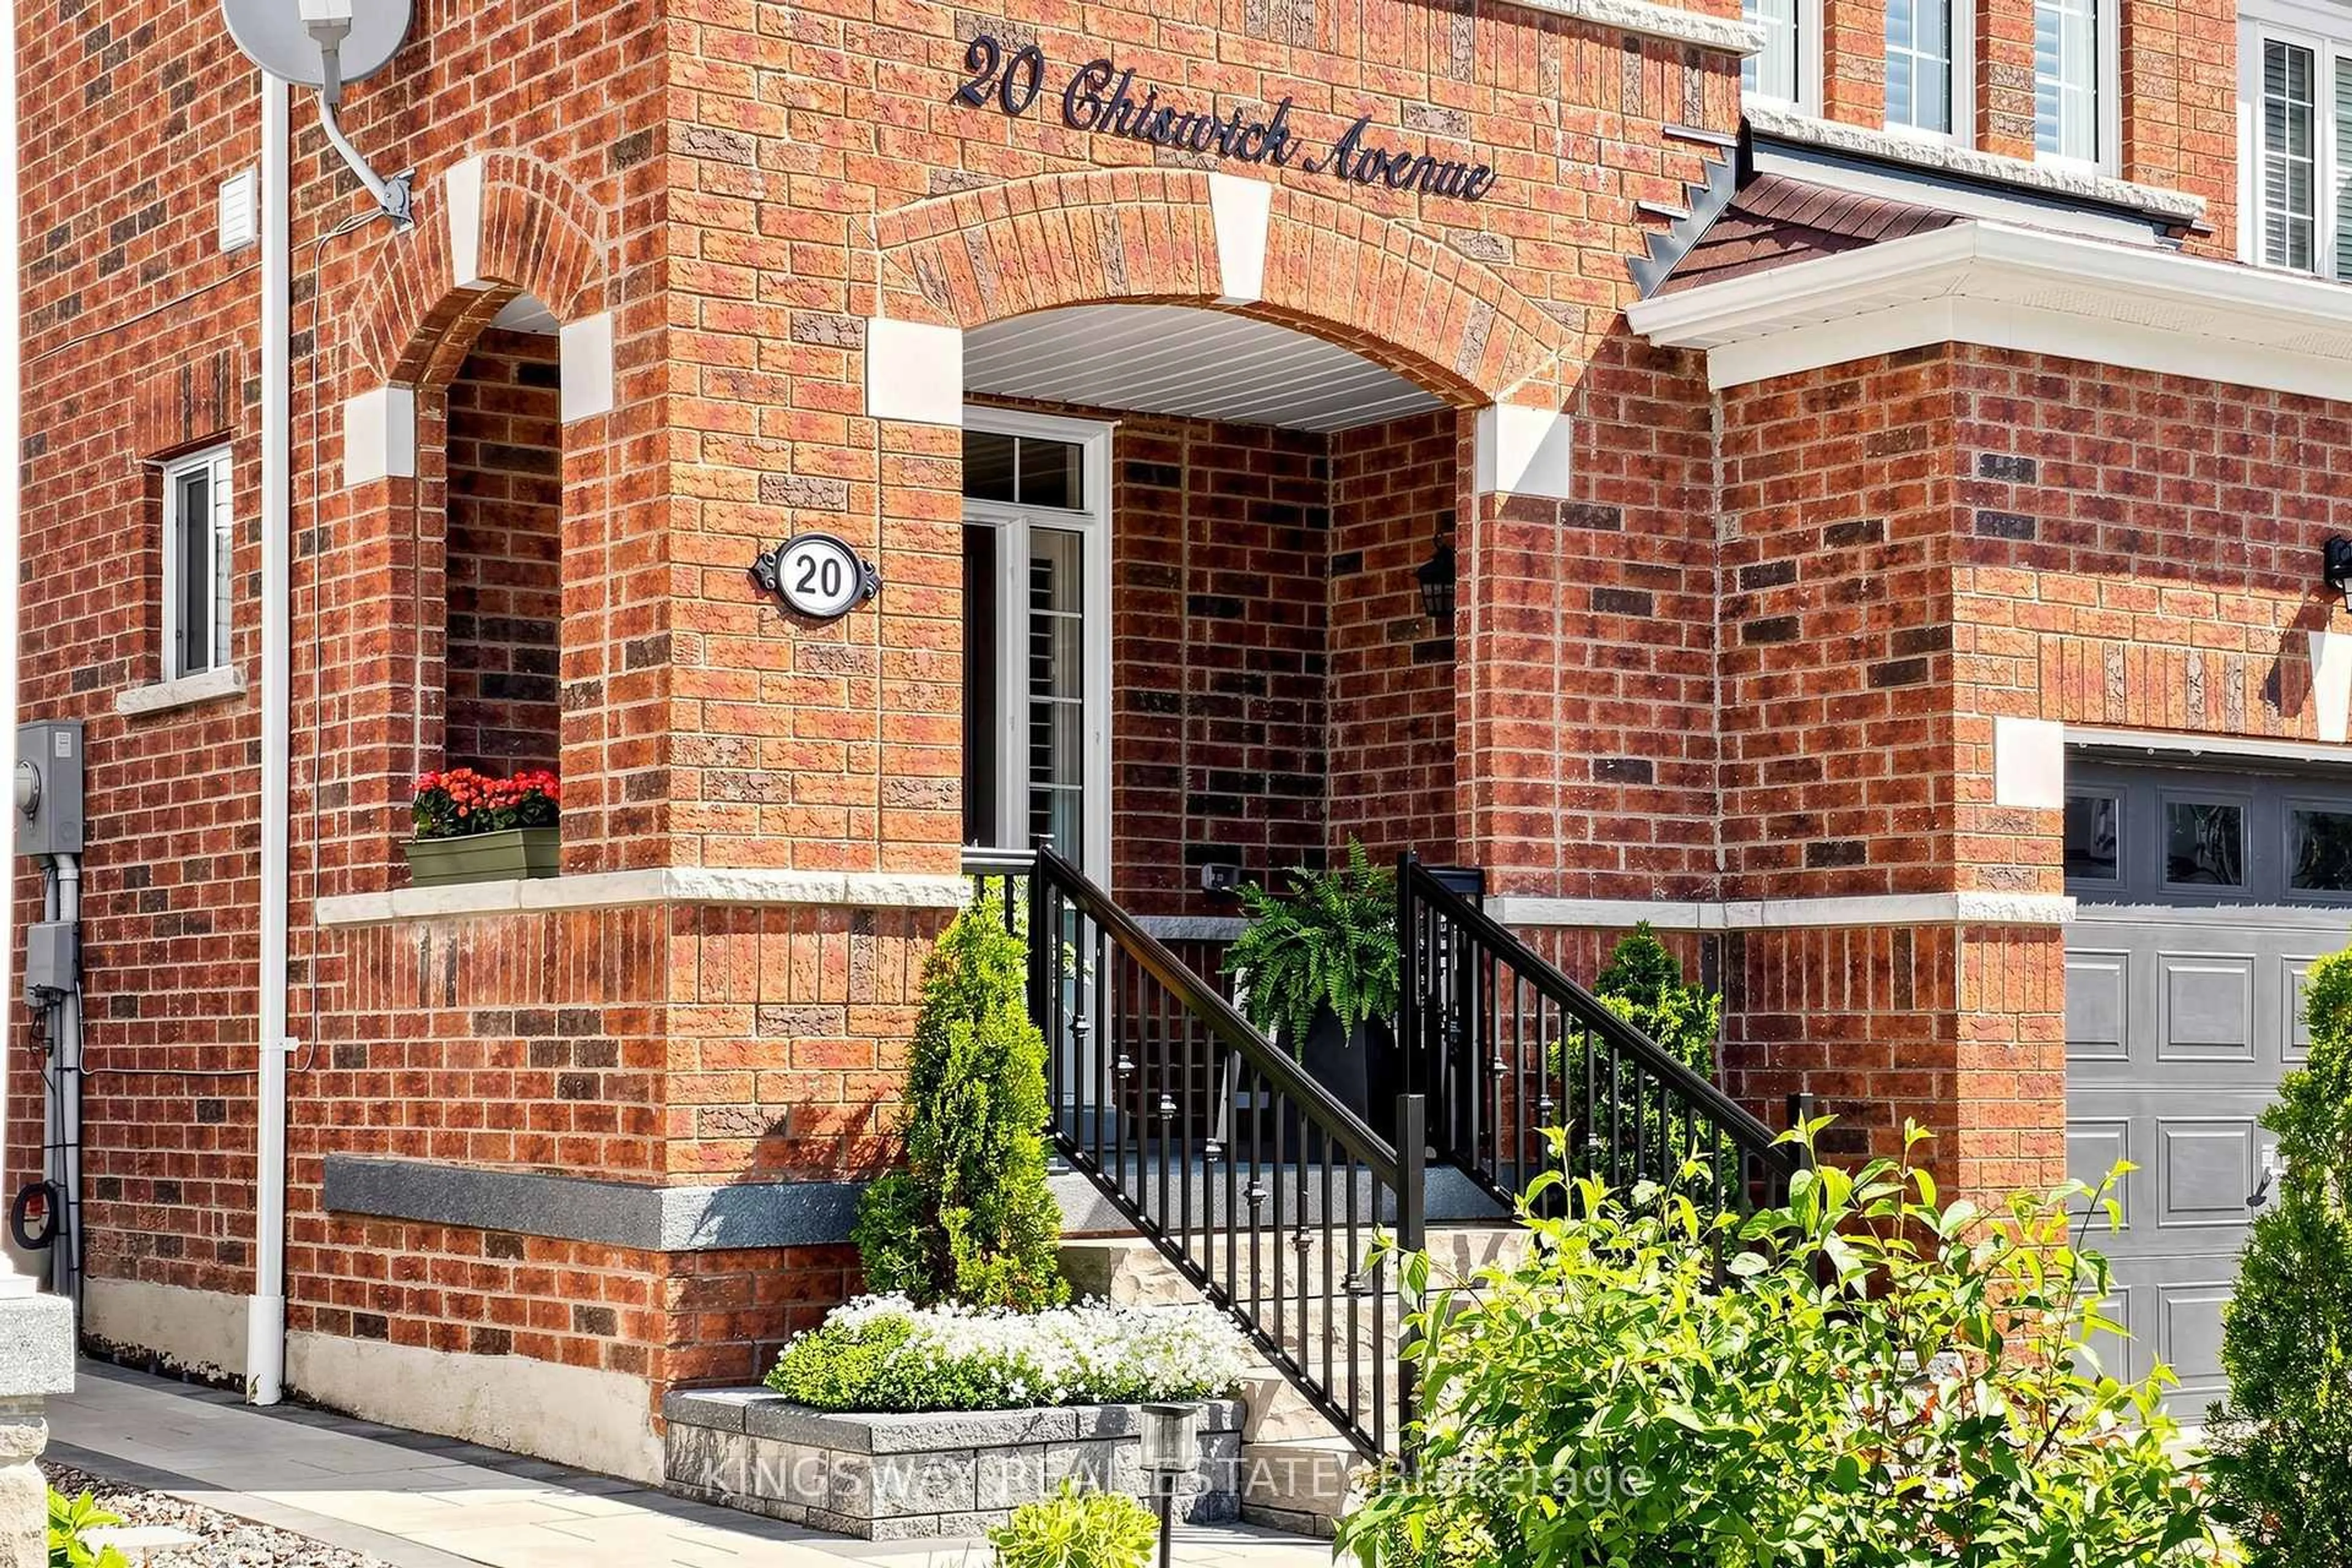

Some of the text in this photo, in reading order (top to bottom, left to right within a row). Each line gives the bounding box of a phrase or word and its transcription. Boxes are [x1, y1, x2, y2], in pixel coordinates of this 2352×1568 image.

[951, 36, 1497, 200] 20 Chiswick Avenue
[795, 554, 842, 598] 20
